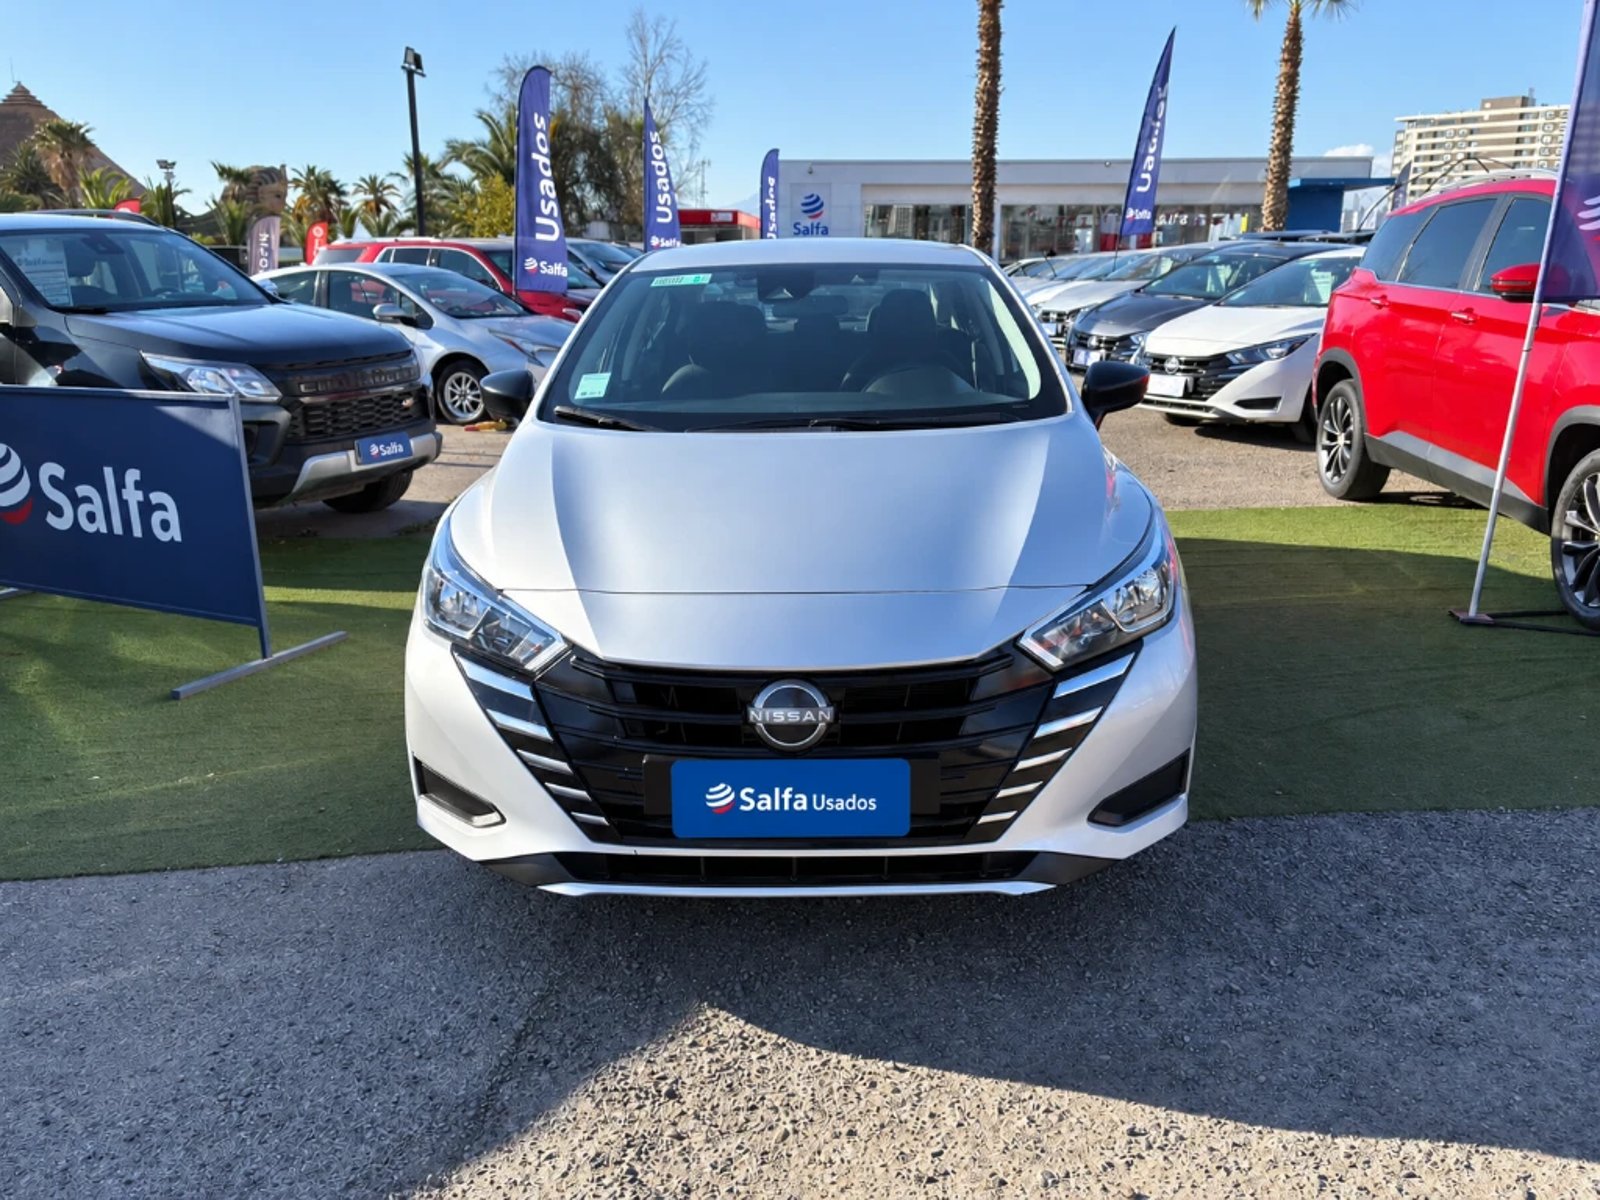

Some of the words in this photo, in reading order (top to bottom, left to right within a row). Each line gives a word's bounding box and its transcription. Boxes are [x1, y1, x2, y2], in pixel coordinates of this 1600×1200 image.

[531, 112, 560, 242] Usados
[650, 131, 673, 223] Usados
[793, 222, 829, 236] Salfa
[540, 261, 568, 277] Salfa
[379, 442, 404, 456] Salfa
[38, 461, 182, 543] Salfa
[749, 709, 831, 723] NISSAN
[739, 787, 808, 811] Salfa
[812, 794, 877, 811] Usados
